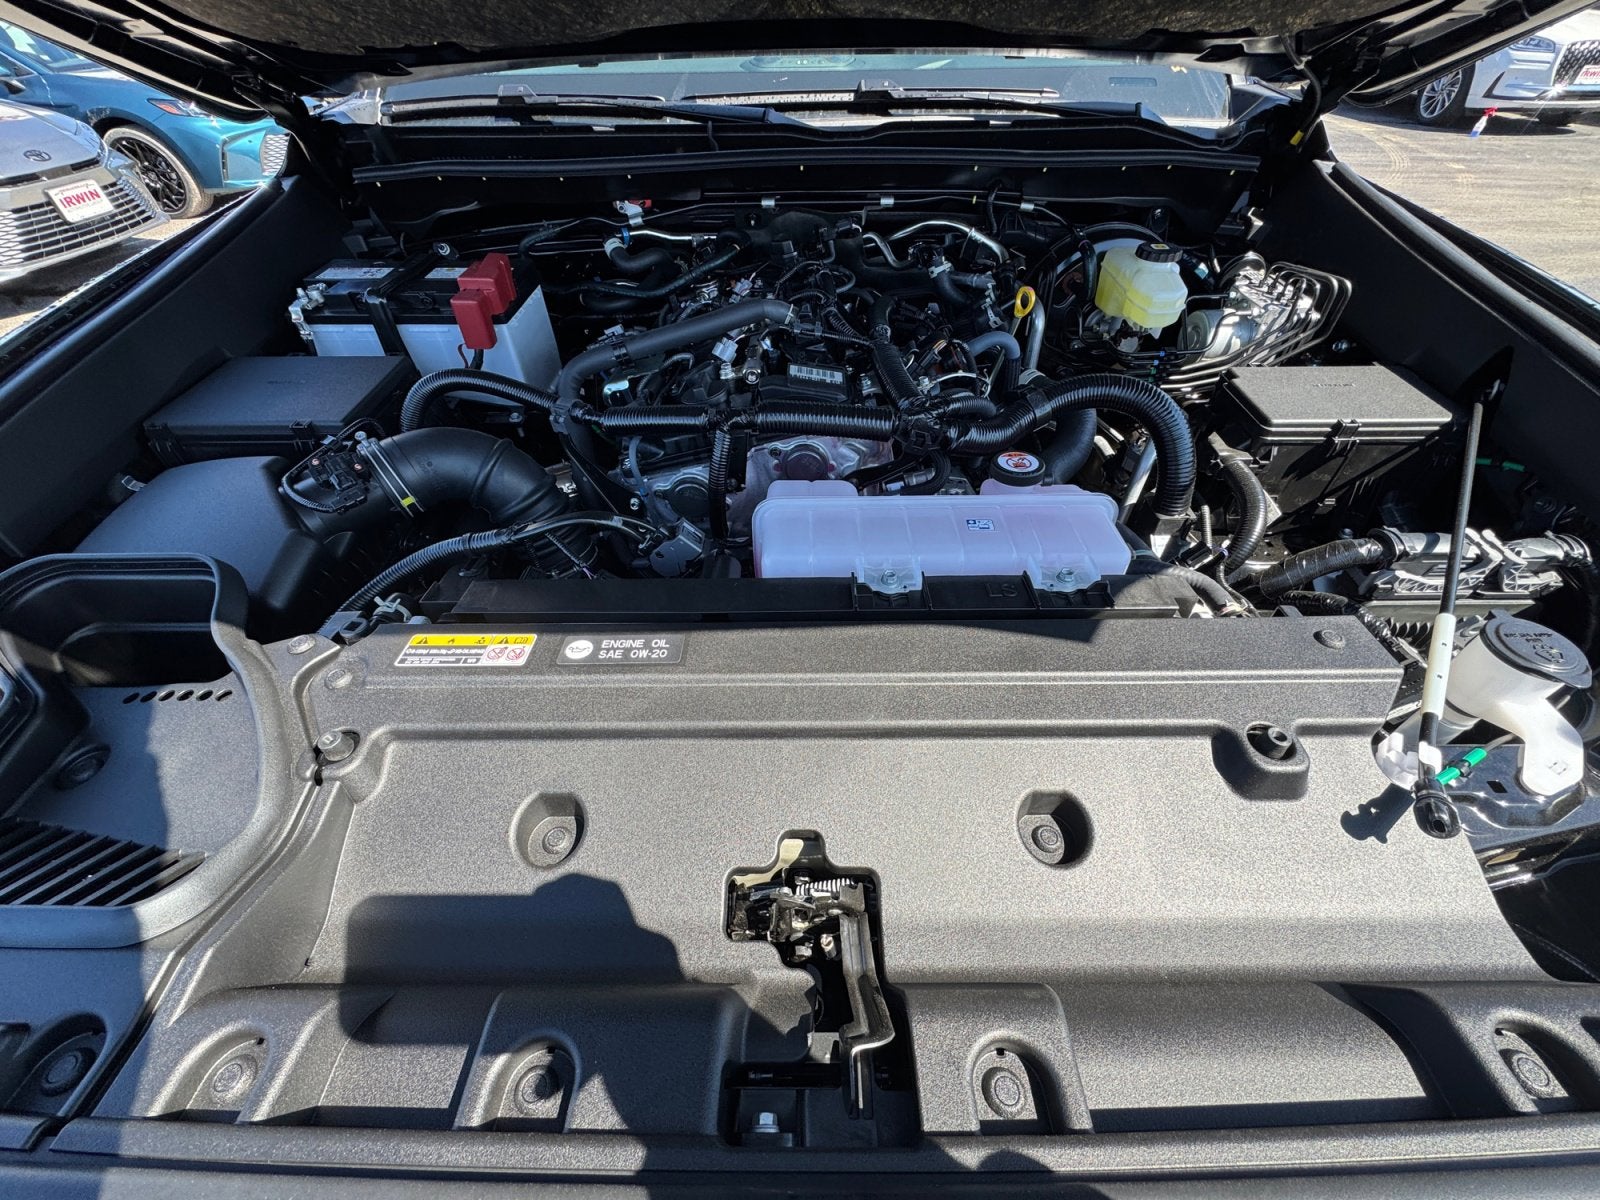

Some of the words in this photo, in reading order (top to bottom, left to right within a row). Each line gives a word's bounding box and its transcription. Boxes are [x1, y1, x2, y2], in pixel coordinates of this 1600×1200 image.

[59, 189, 101, 208] IRWIN
[601, 639, 645, 648] ENGINE
[651, 639, 670, 648] OIL
[598, 649, 624, 658] SAE
[630, 649, 668, 658] 0W-20
